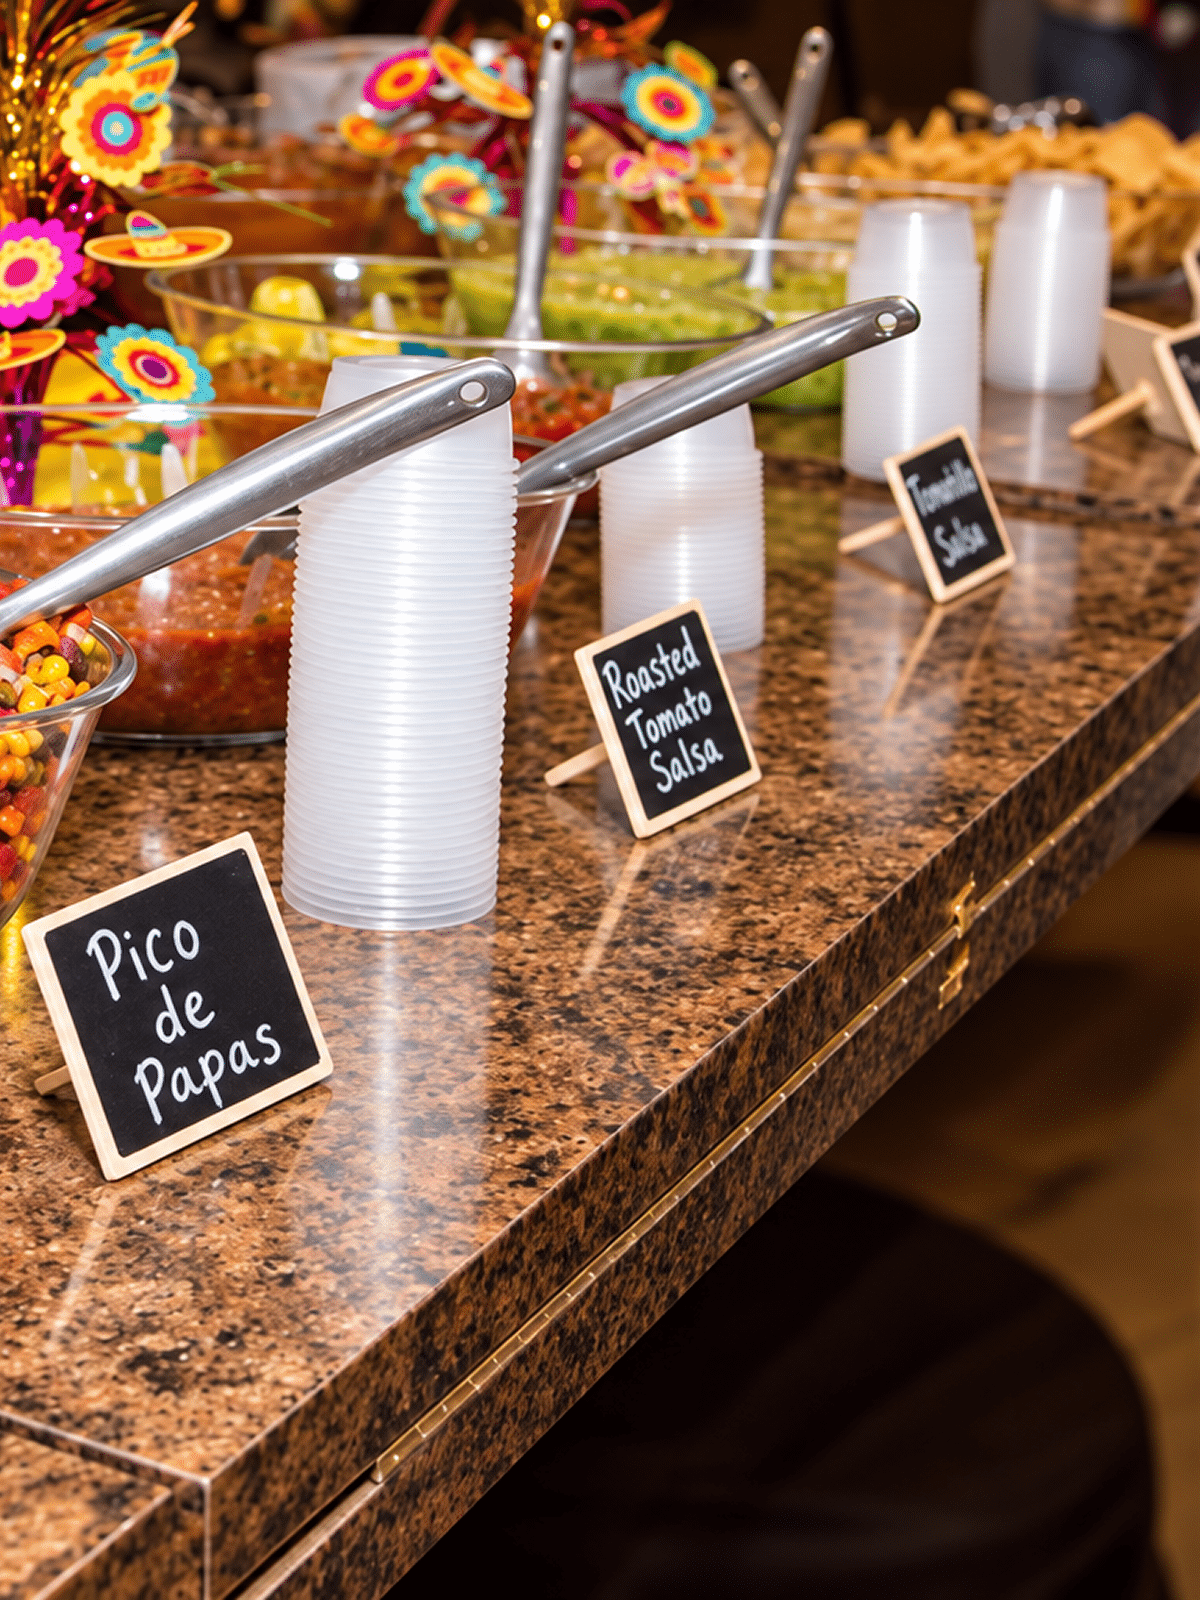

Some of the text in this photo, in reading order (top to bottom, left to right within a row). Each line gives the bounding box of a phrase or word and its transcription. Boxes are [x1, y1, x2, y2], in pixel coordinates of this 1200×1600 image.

[933, 516, 989, 569] Salsa
[601, 624, 702, 710] Roasted
[624, 686, 713, 750] Tomato
[649, 737, 725, 794] Salsa
[85, 919, 201, 1002] Pico
[155, 983, 216, 1045] de
[133, 1023, 282, 1126] Papas
